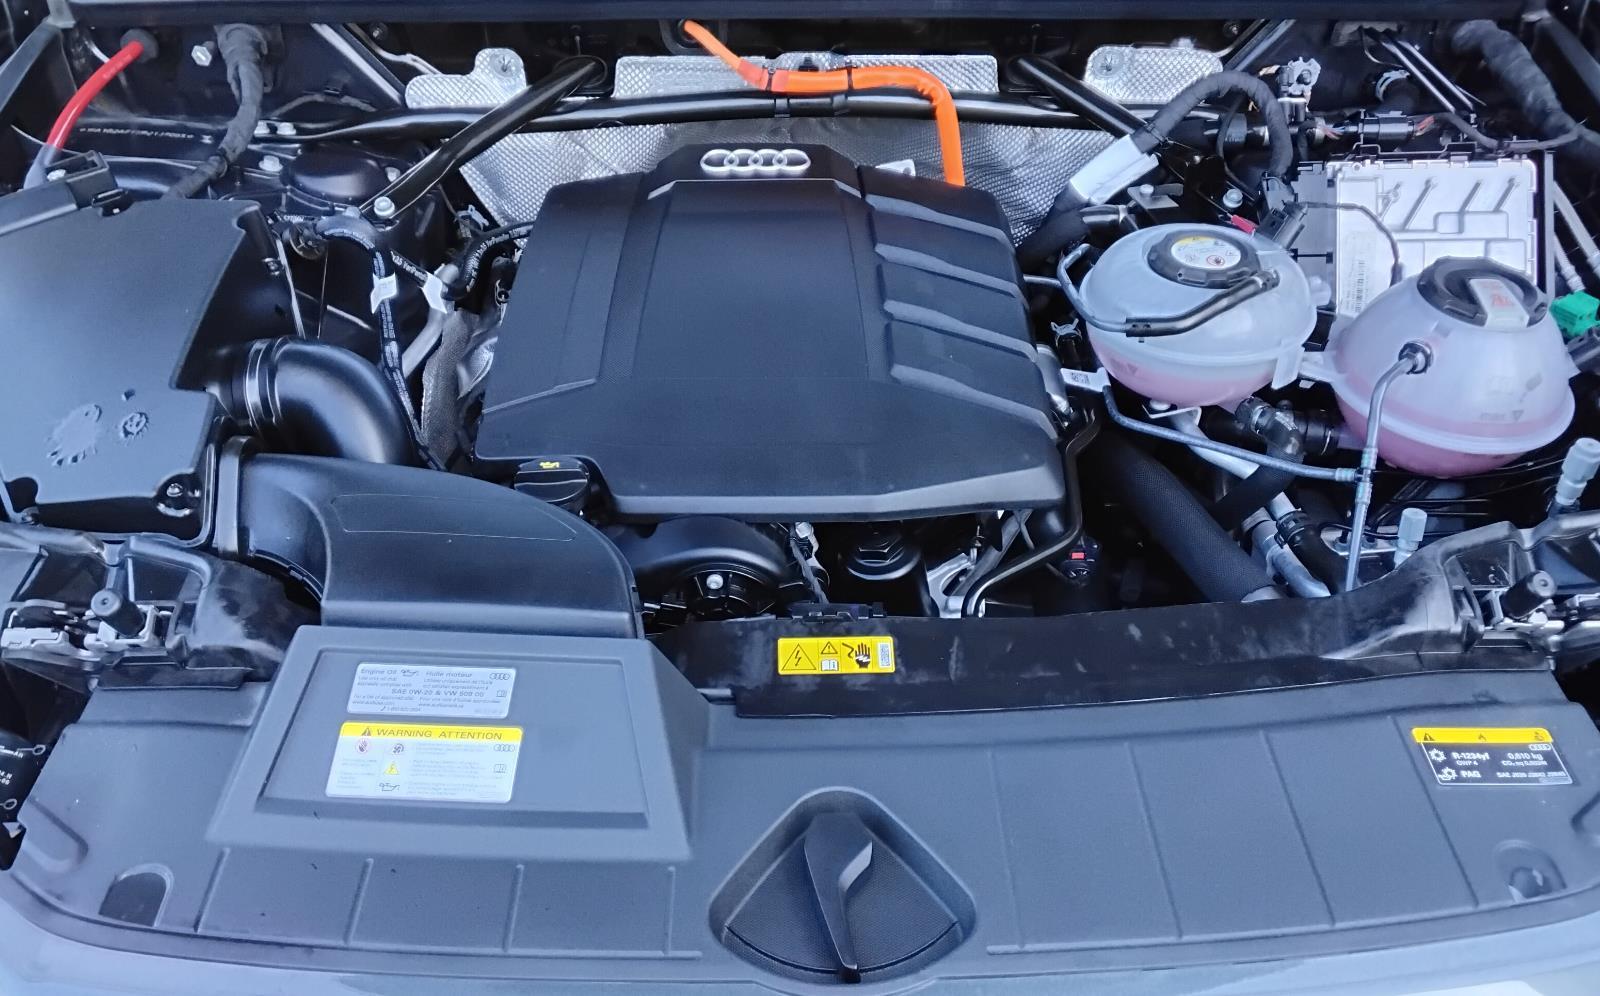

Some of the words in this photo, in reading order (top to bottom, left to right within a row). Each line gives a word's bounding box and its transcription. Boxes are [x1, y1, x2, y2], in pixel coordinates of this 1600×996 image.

[361, 668, 385, 676] Engine
[376, 728, 433, 738] WARNING
[438, 730, 503, 741] ATTENTION
[1530, 752, 1544, 761] kg
